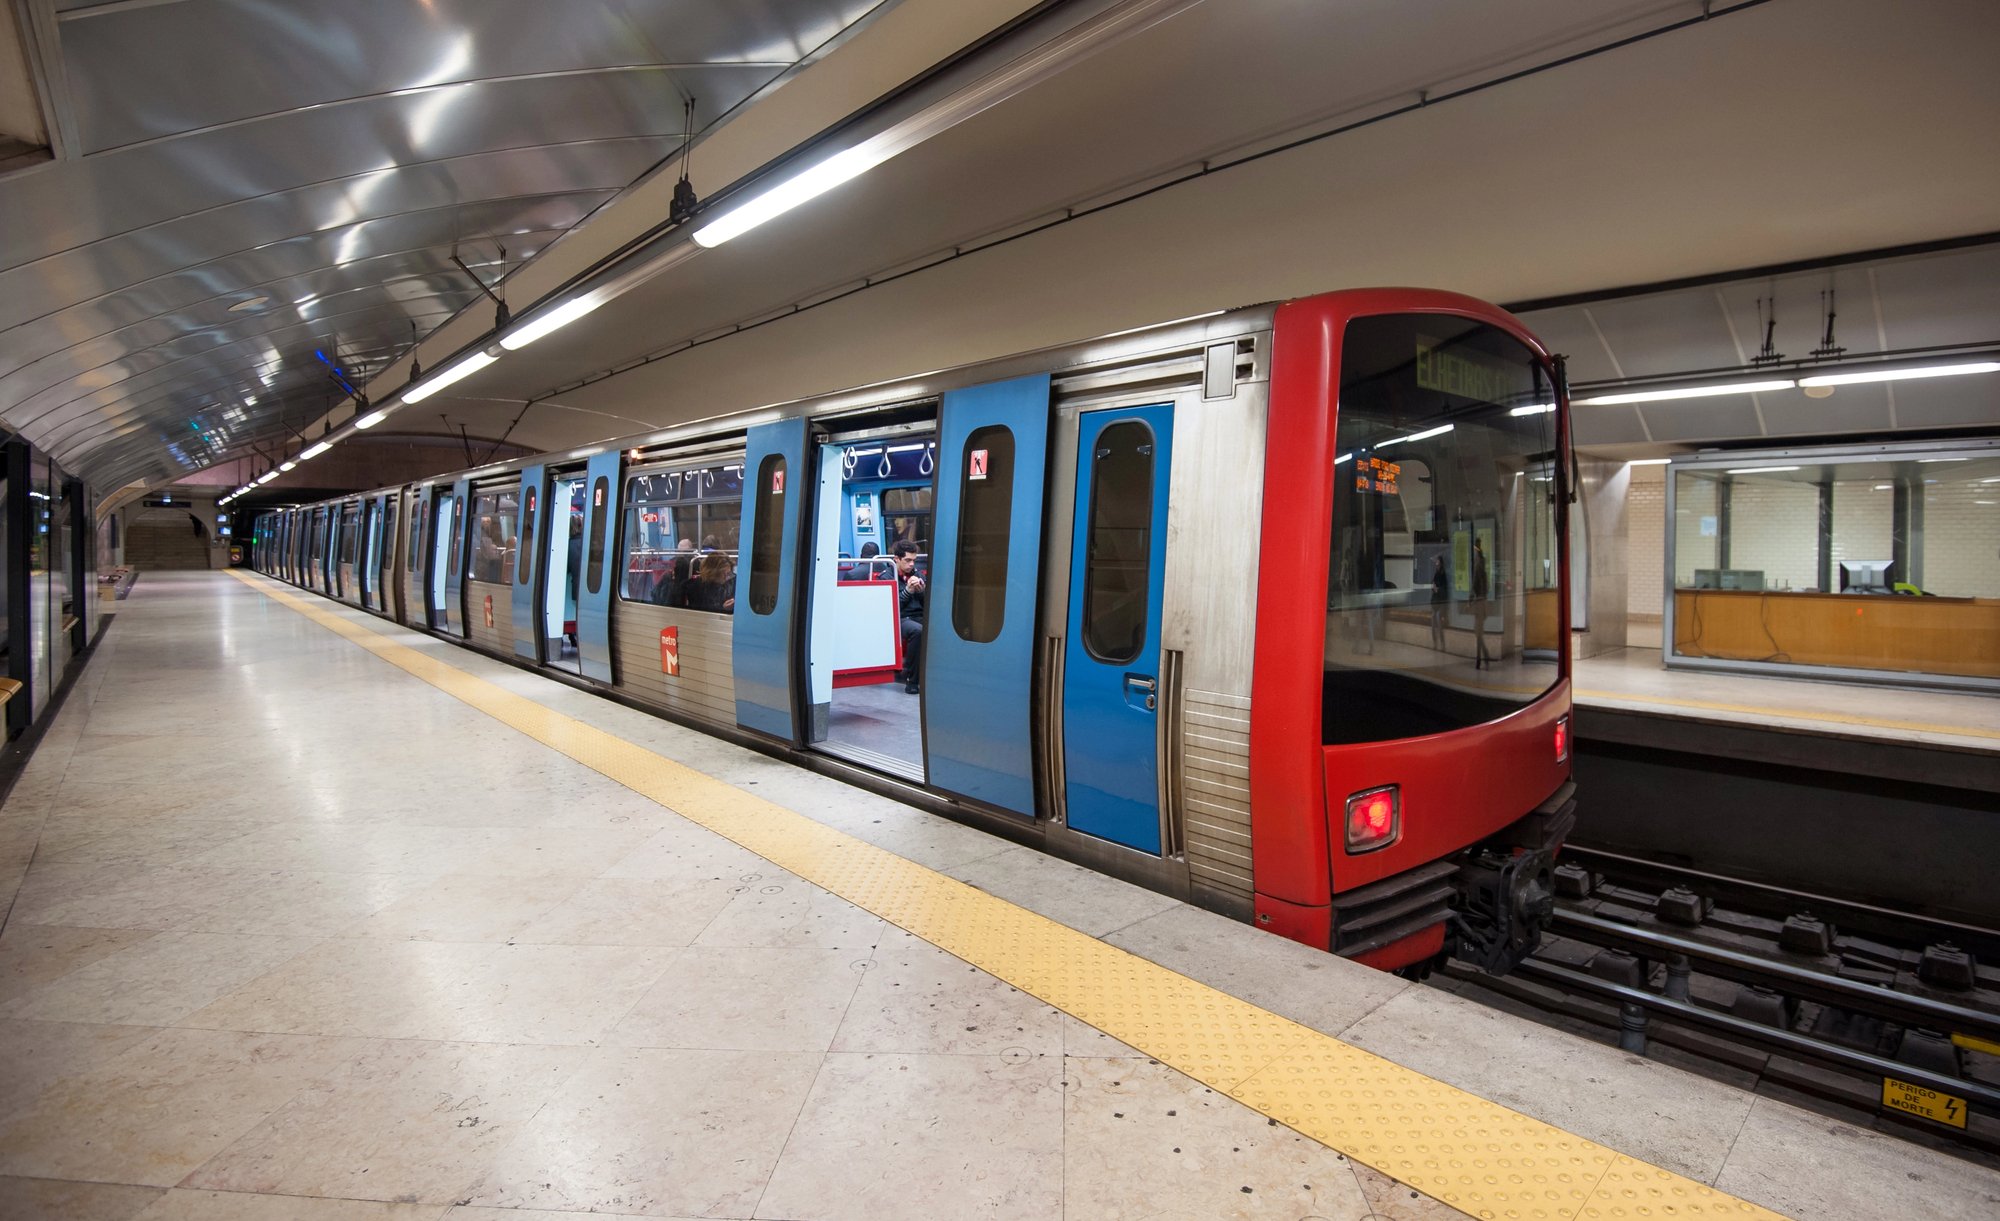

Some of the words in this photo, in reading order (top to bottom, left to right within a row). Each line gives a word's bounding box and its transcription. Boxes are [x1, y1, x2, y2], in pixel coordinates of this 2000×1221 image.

[661, 635, 676, 646] metro
[1890, 1080, 1936, 1100] PERIGO
[1904, 1093, 1920, 1103] DE
[1891, 1098, 1934, 1116] MORTE
